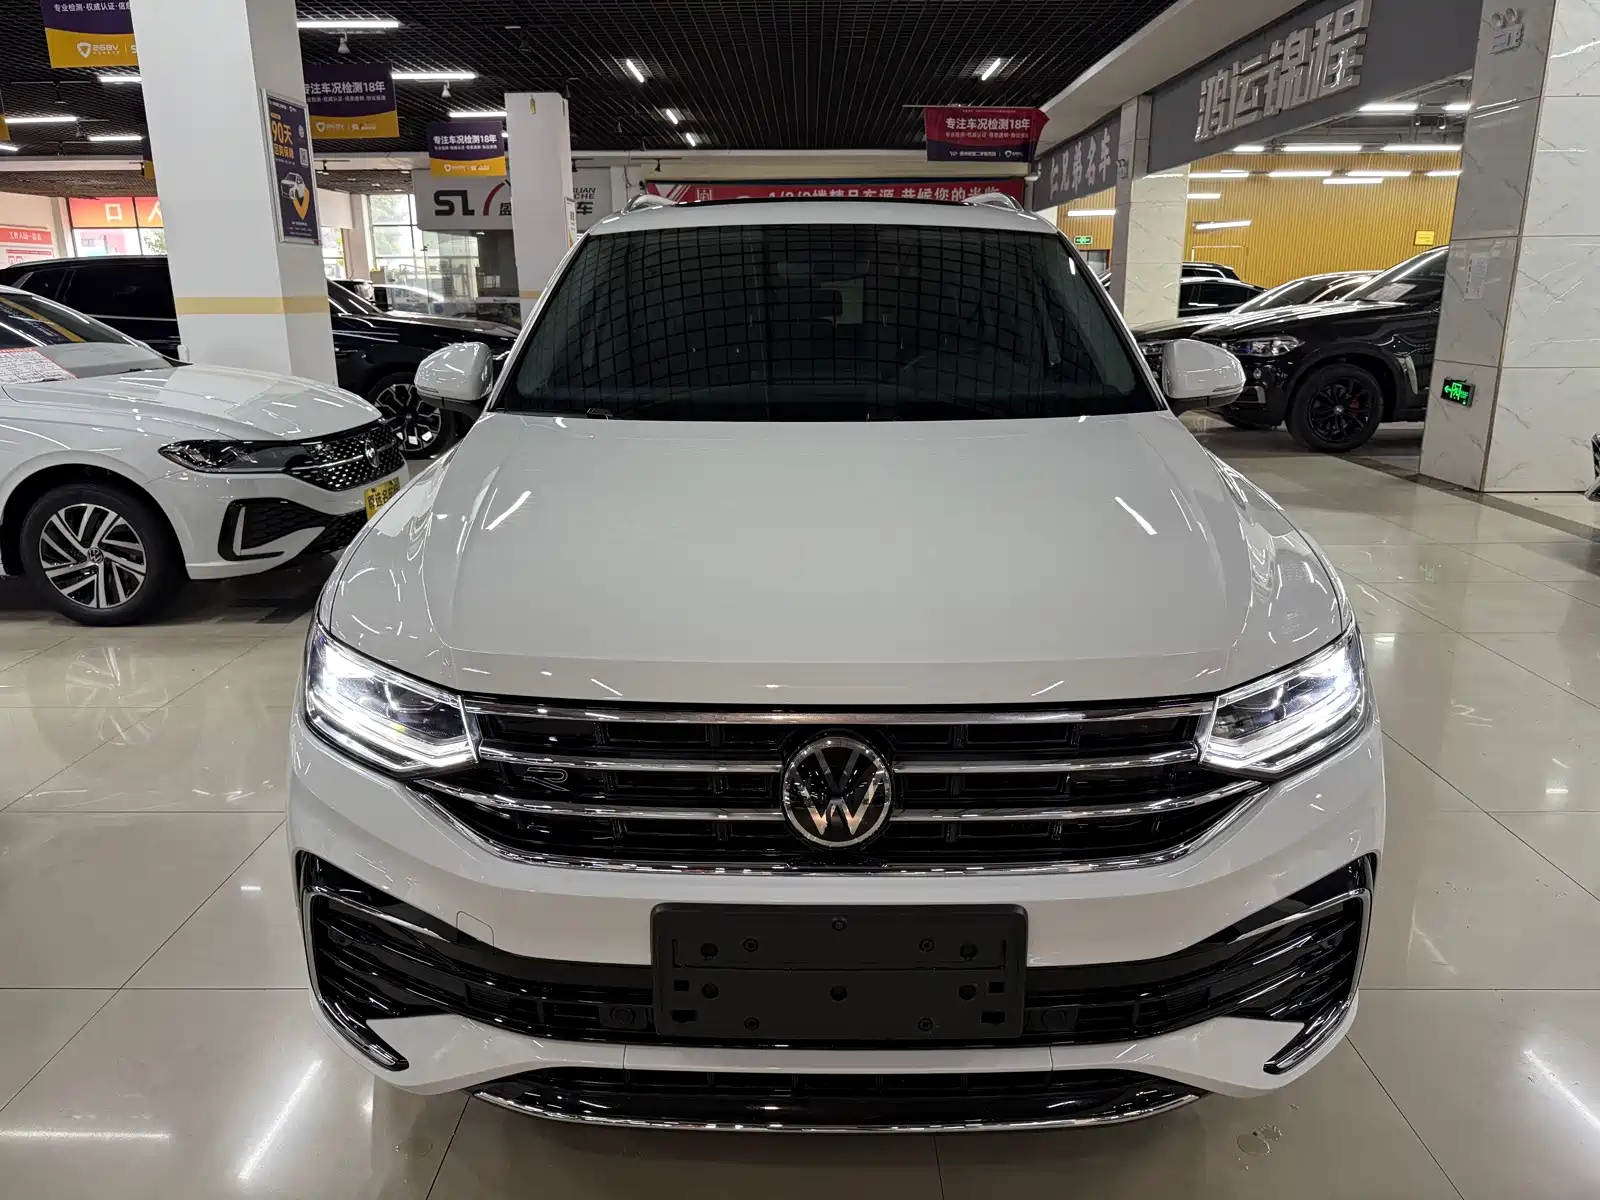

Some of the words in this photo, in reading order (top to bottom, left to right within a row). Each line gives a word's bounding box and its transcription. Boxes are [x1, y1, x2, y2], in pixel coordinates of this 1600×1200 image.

[1195, 0, 1372, 142] 鸿运锦程
[271, 120, 293, 145] 90天
[945, 118, 1031, 130] 专注车况检测18年
[433, 134, 497, 145] 专注车况检测18年
